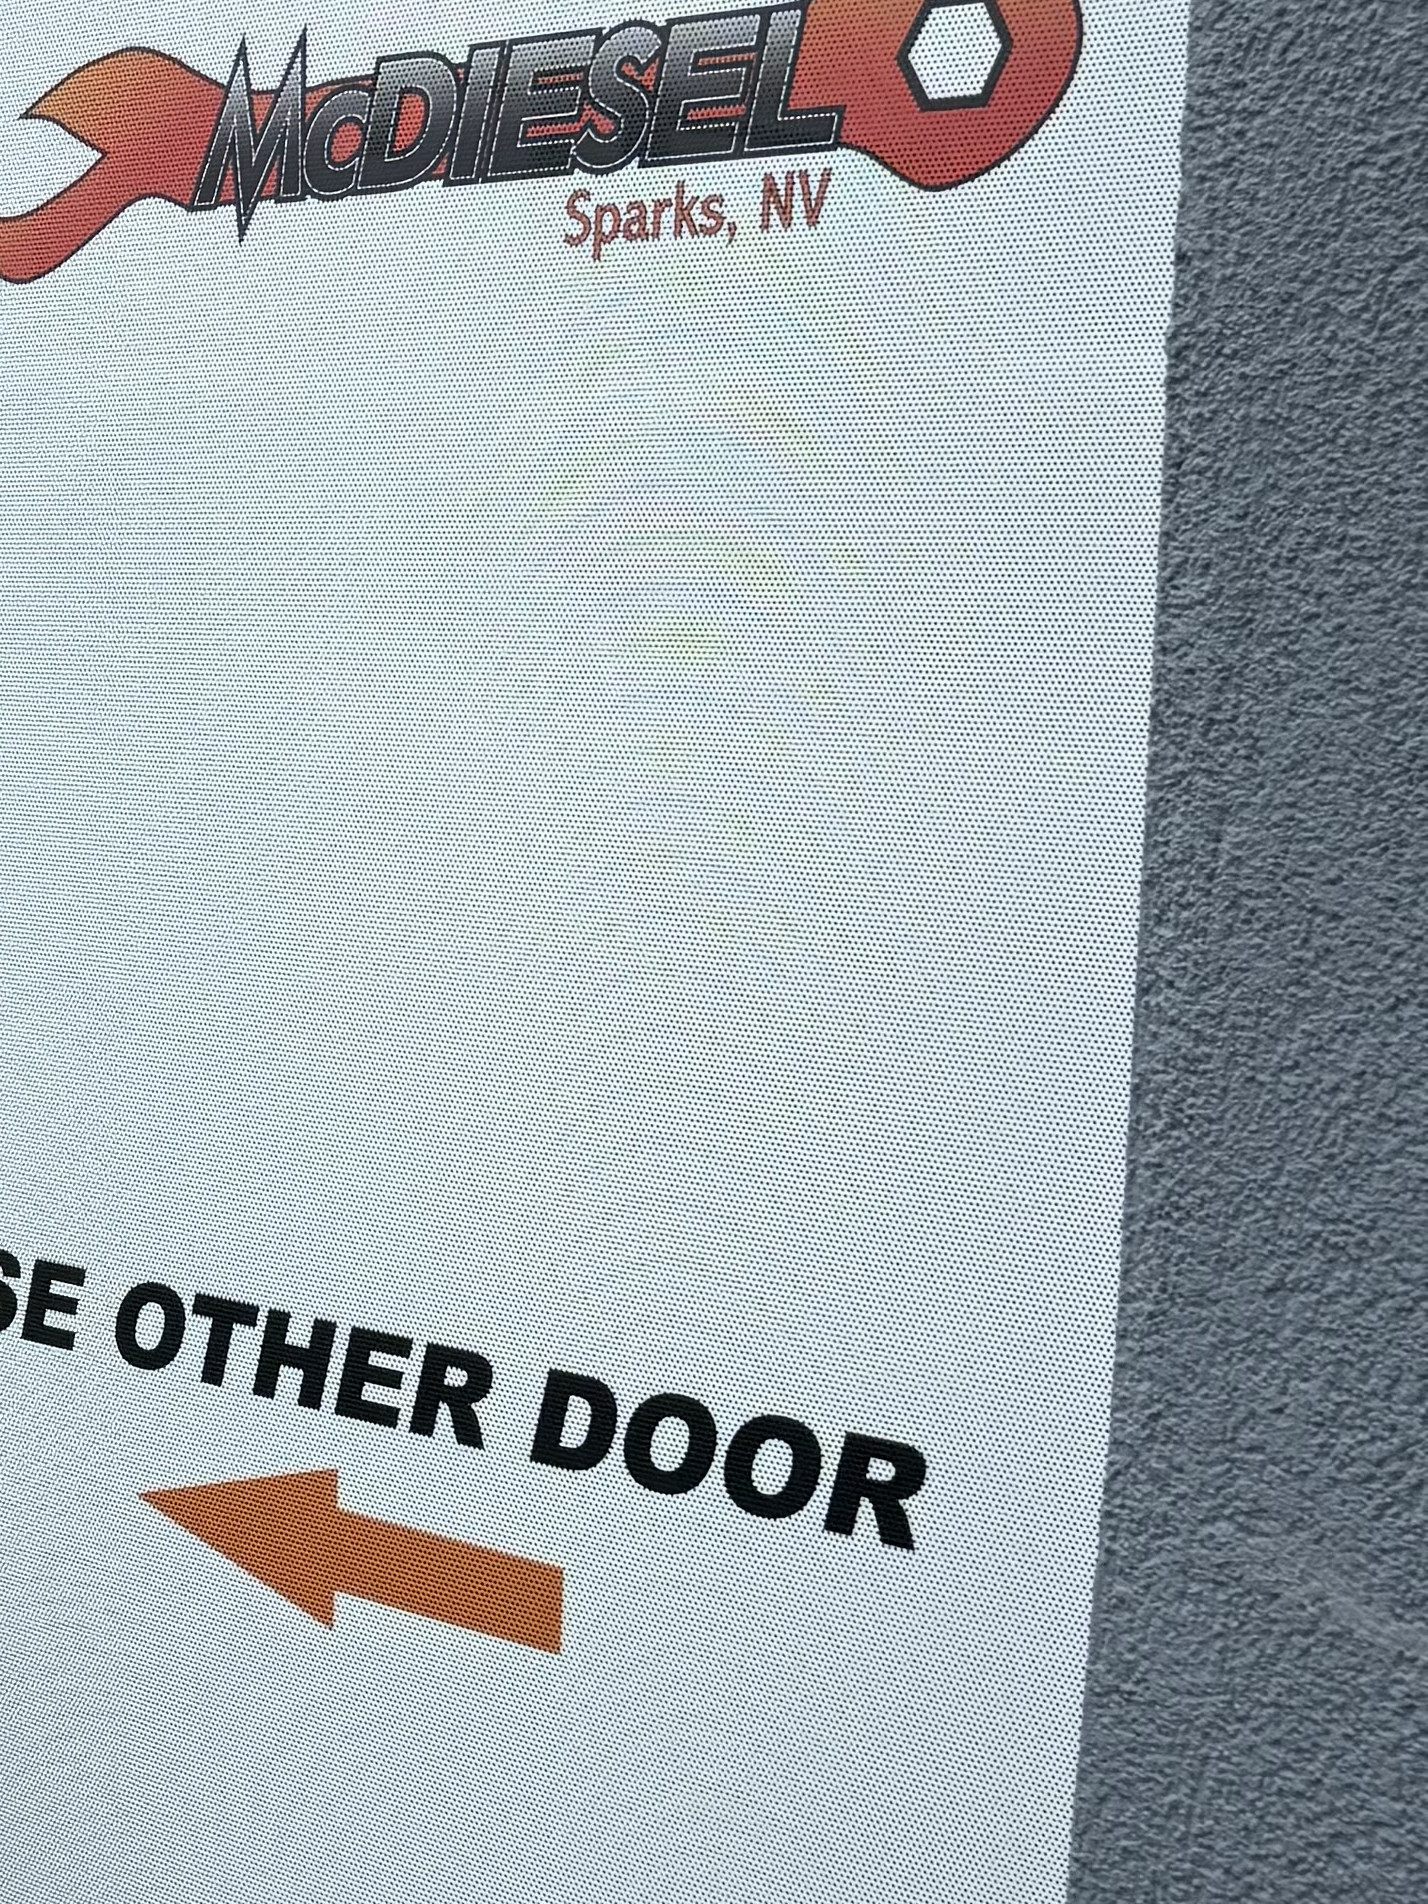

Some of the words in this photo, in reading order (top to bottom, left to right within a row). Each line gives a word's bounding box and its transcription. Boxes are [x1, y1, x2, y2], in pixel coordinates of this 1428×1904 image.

[563, 173, 738, 260] Sparks,
[760, 169, 832, 232] NV
[114, 1280, 494, 1449] OTHER
[528, 1369, 927, 1551] DOOR
